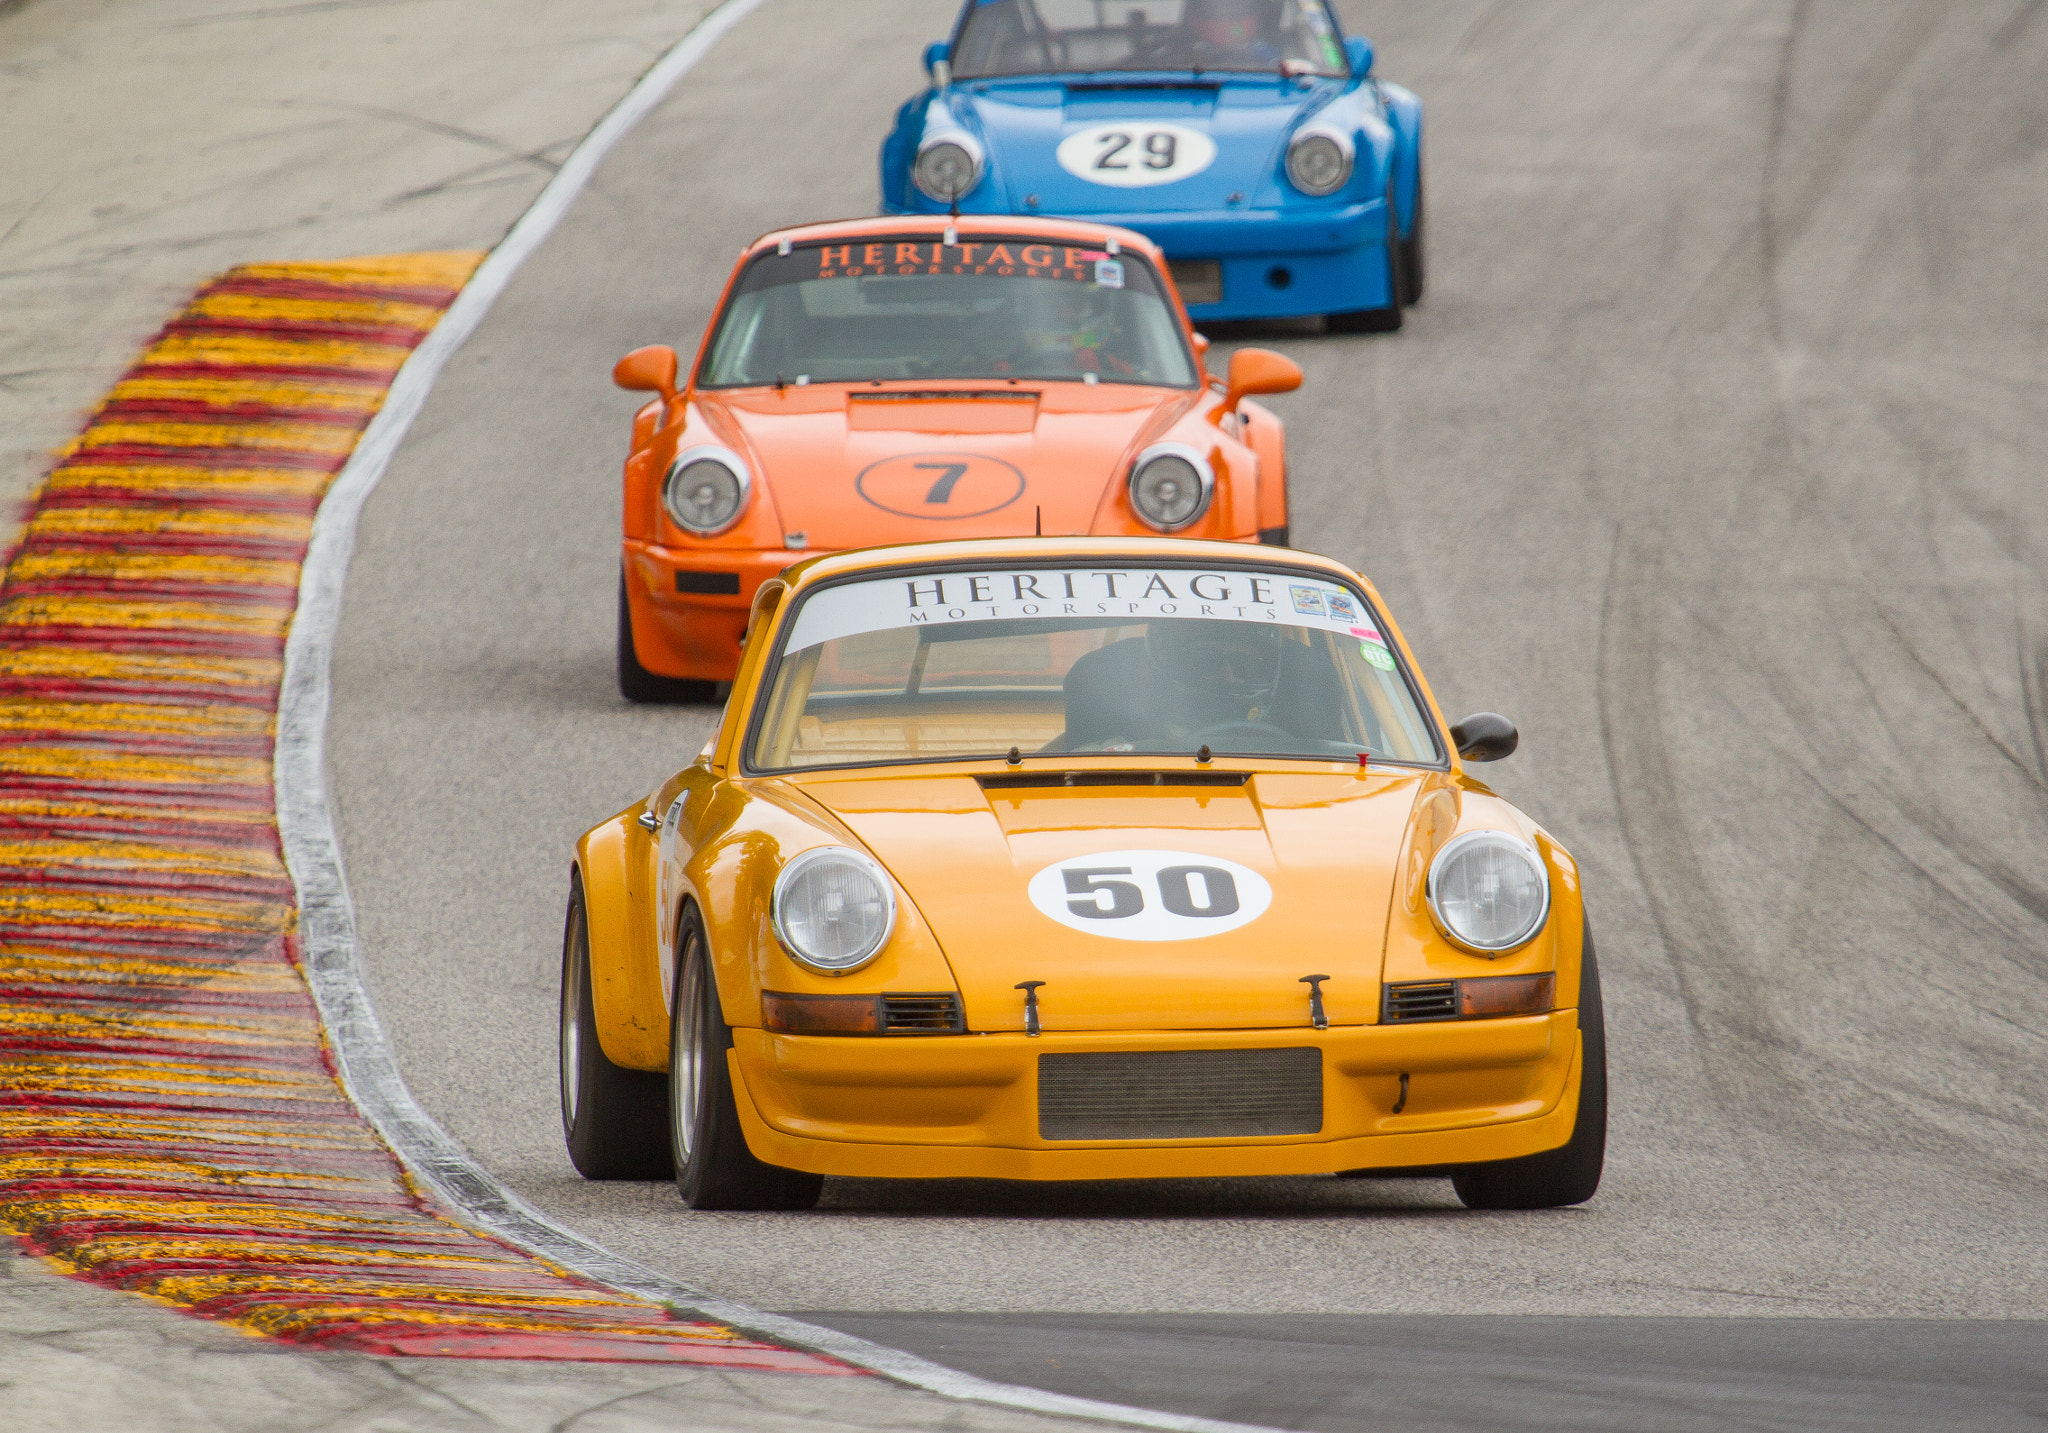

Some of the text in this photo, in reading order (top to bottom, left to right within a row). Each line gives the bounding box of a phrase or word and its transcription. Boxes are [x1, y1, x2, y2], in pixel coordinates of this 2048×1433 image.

[1094, 131, 1177, 170] 29
[820, 242, 1086, 270] HERITAGE
[912, 462, 968, 503] 7
[906, 571, 1275, 608] HERITAGE
[908, 601, 1277, 623] MOTORSPORTS
[1060, 864, 1240, 919] 50
